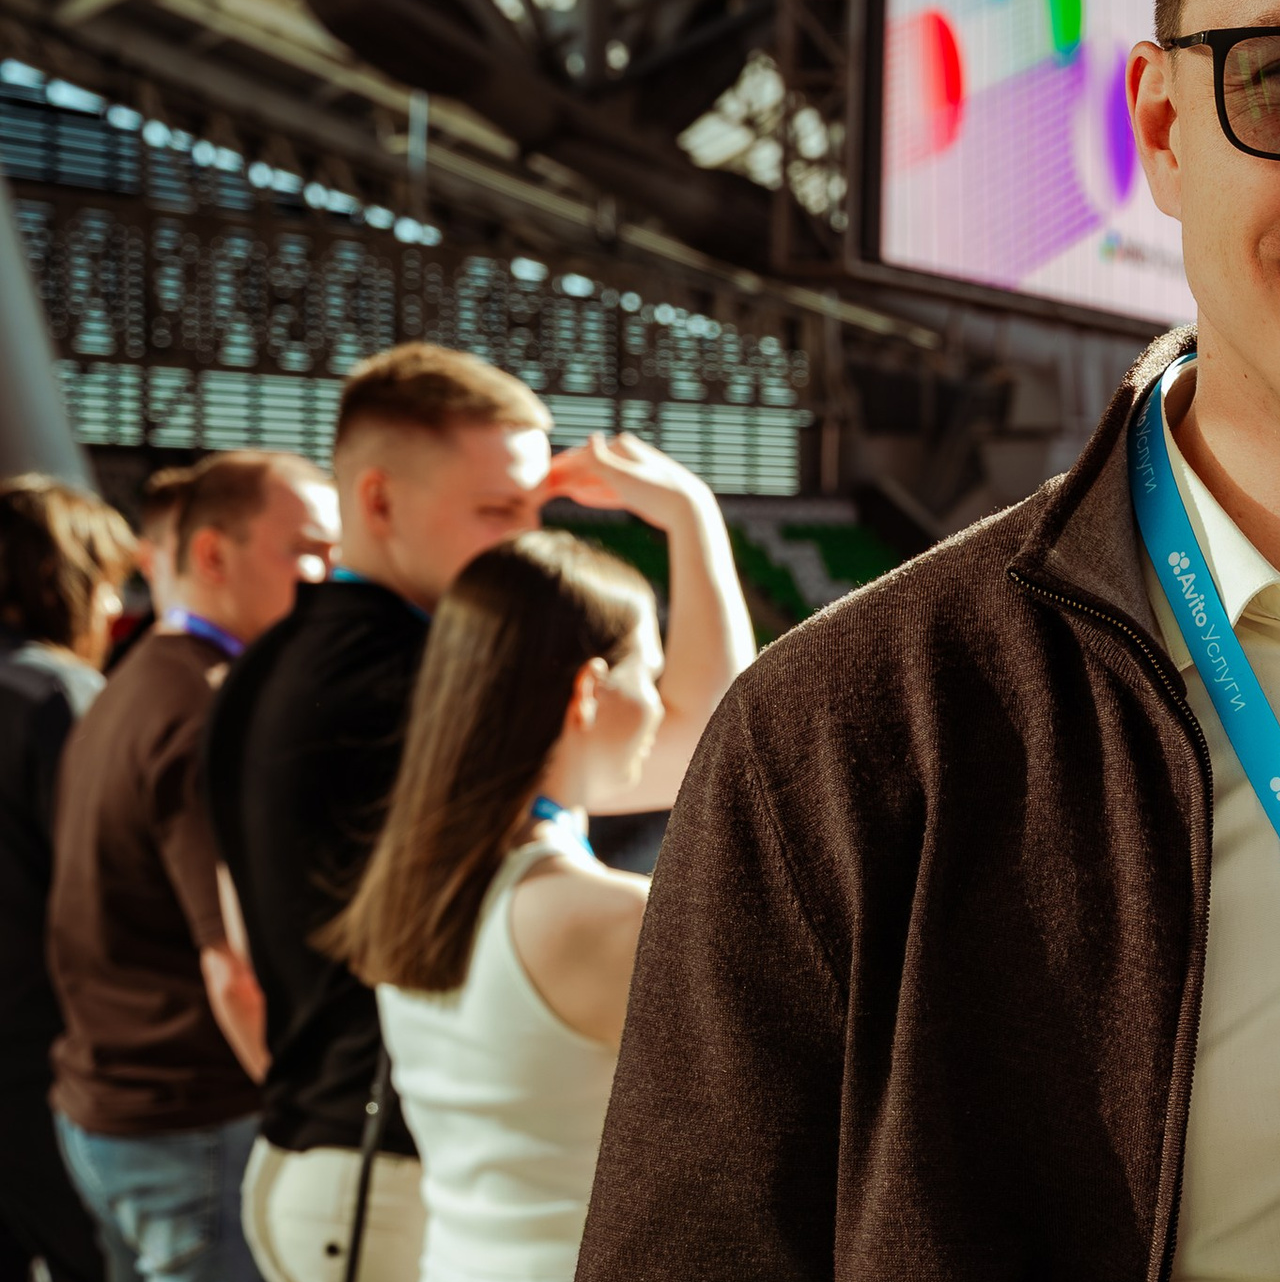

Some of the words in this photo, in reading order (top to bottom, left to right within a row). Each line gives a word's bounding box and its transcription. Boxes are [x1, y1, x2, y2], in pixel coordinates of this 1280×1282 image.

[1136, 421, 1156, 493] Услуги
[1177, 573, 1207, 627] Avito
[1201, 623, 1246, 713] Услуги
